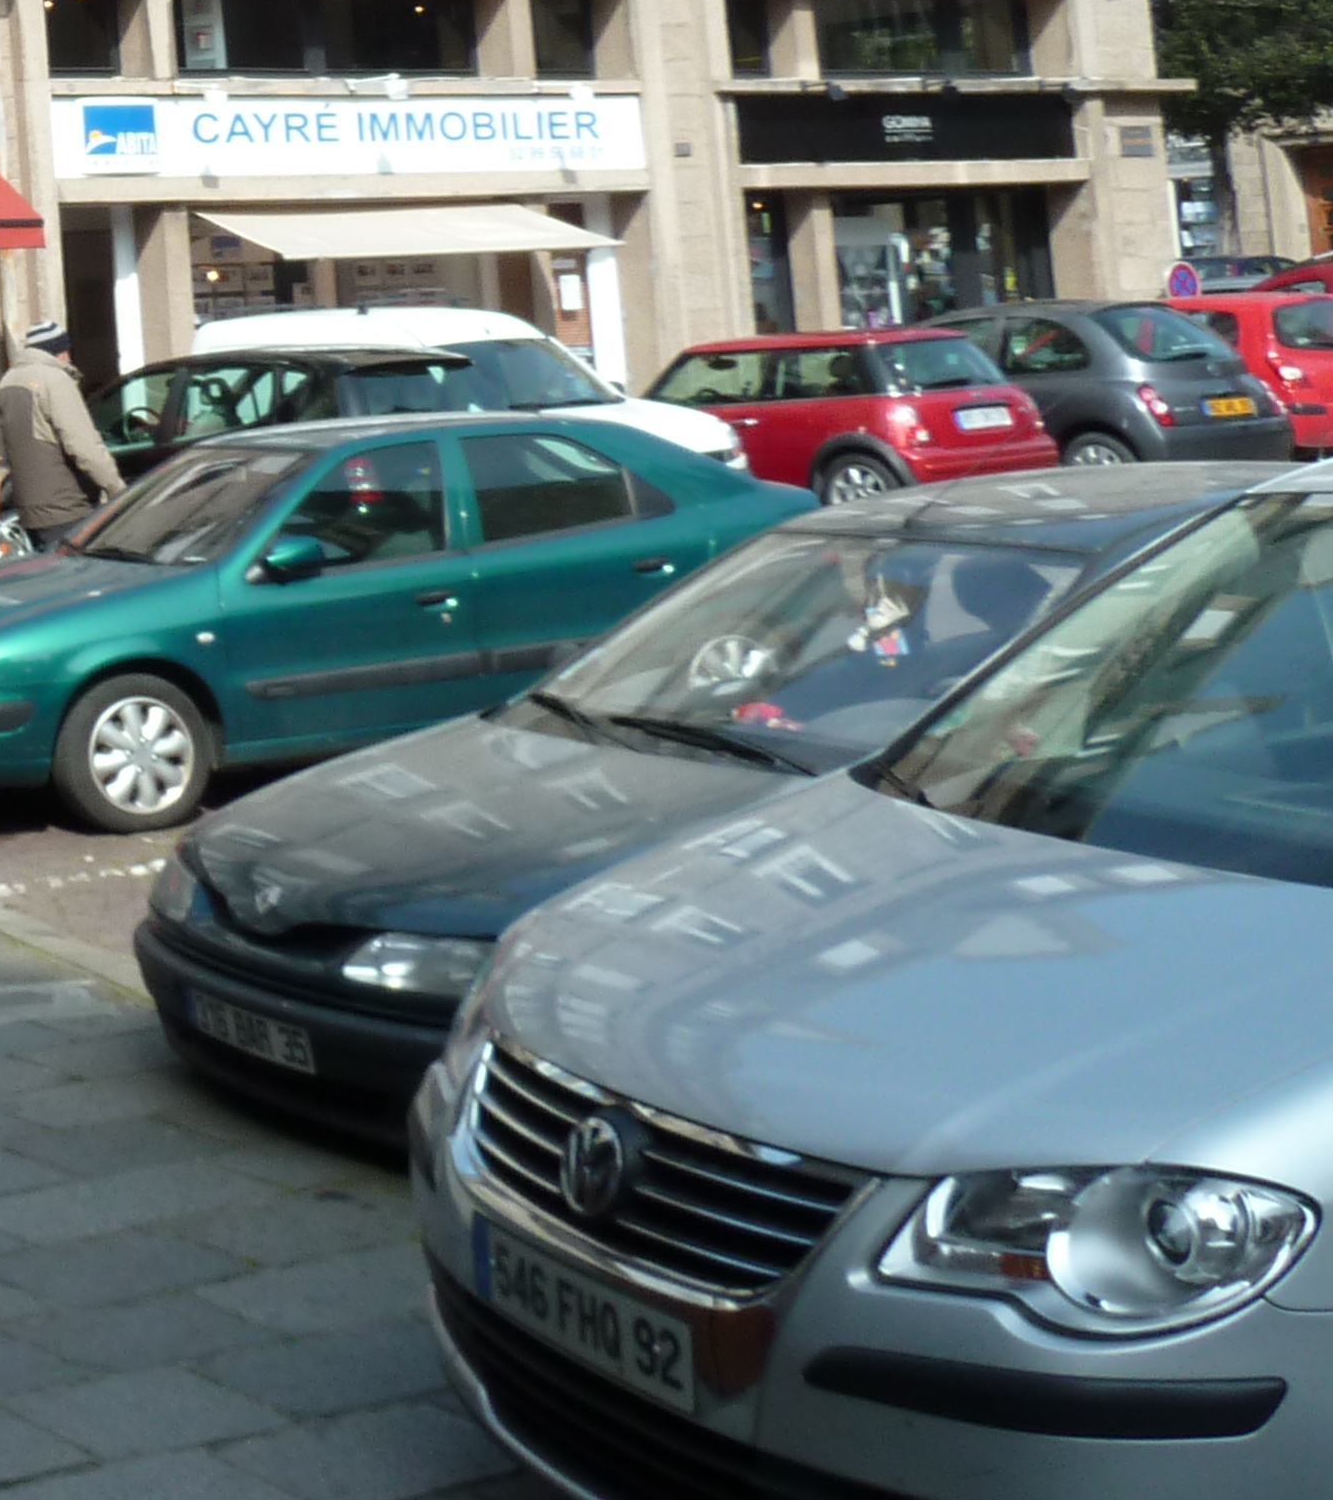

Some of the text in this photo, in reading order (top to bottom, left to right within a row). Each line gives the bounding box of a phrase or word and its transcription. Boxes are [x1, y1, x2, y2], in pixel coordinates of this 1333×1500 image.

[192, 102, 600, 144] CAYRÉ IMMOBILIER
[634, 1316, 684, 1390] 92
